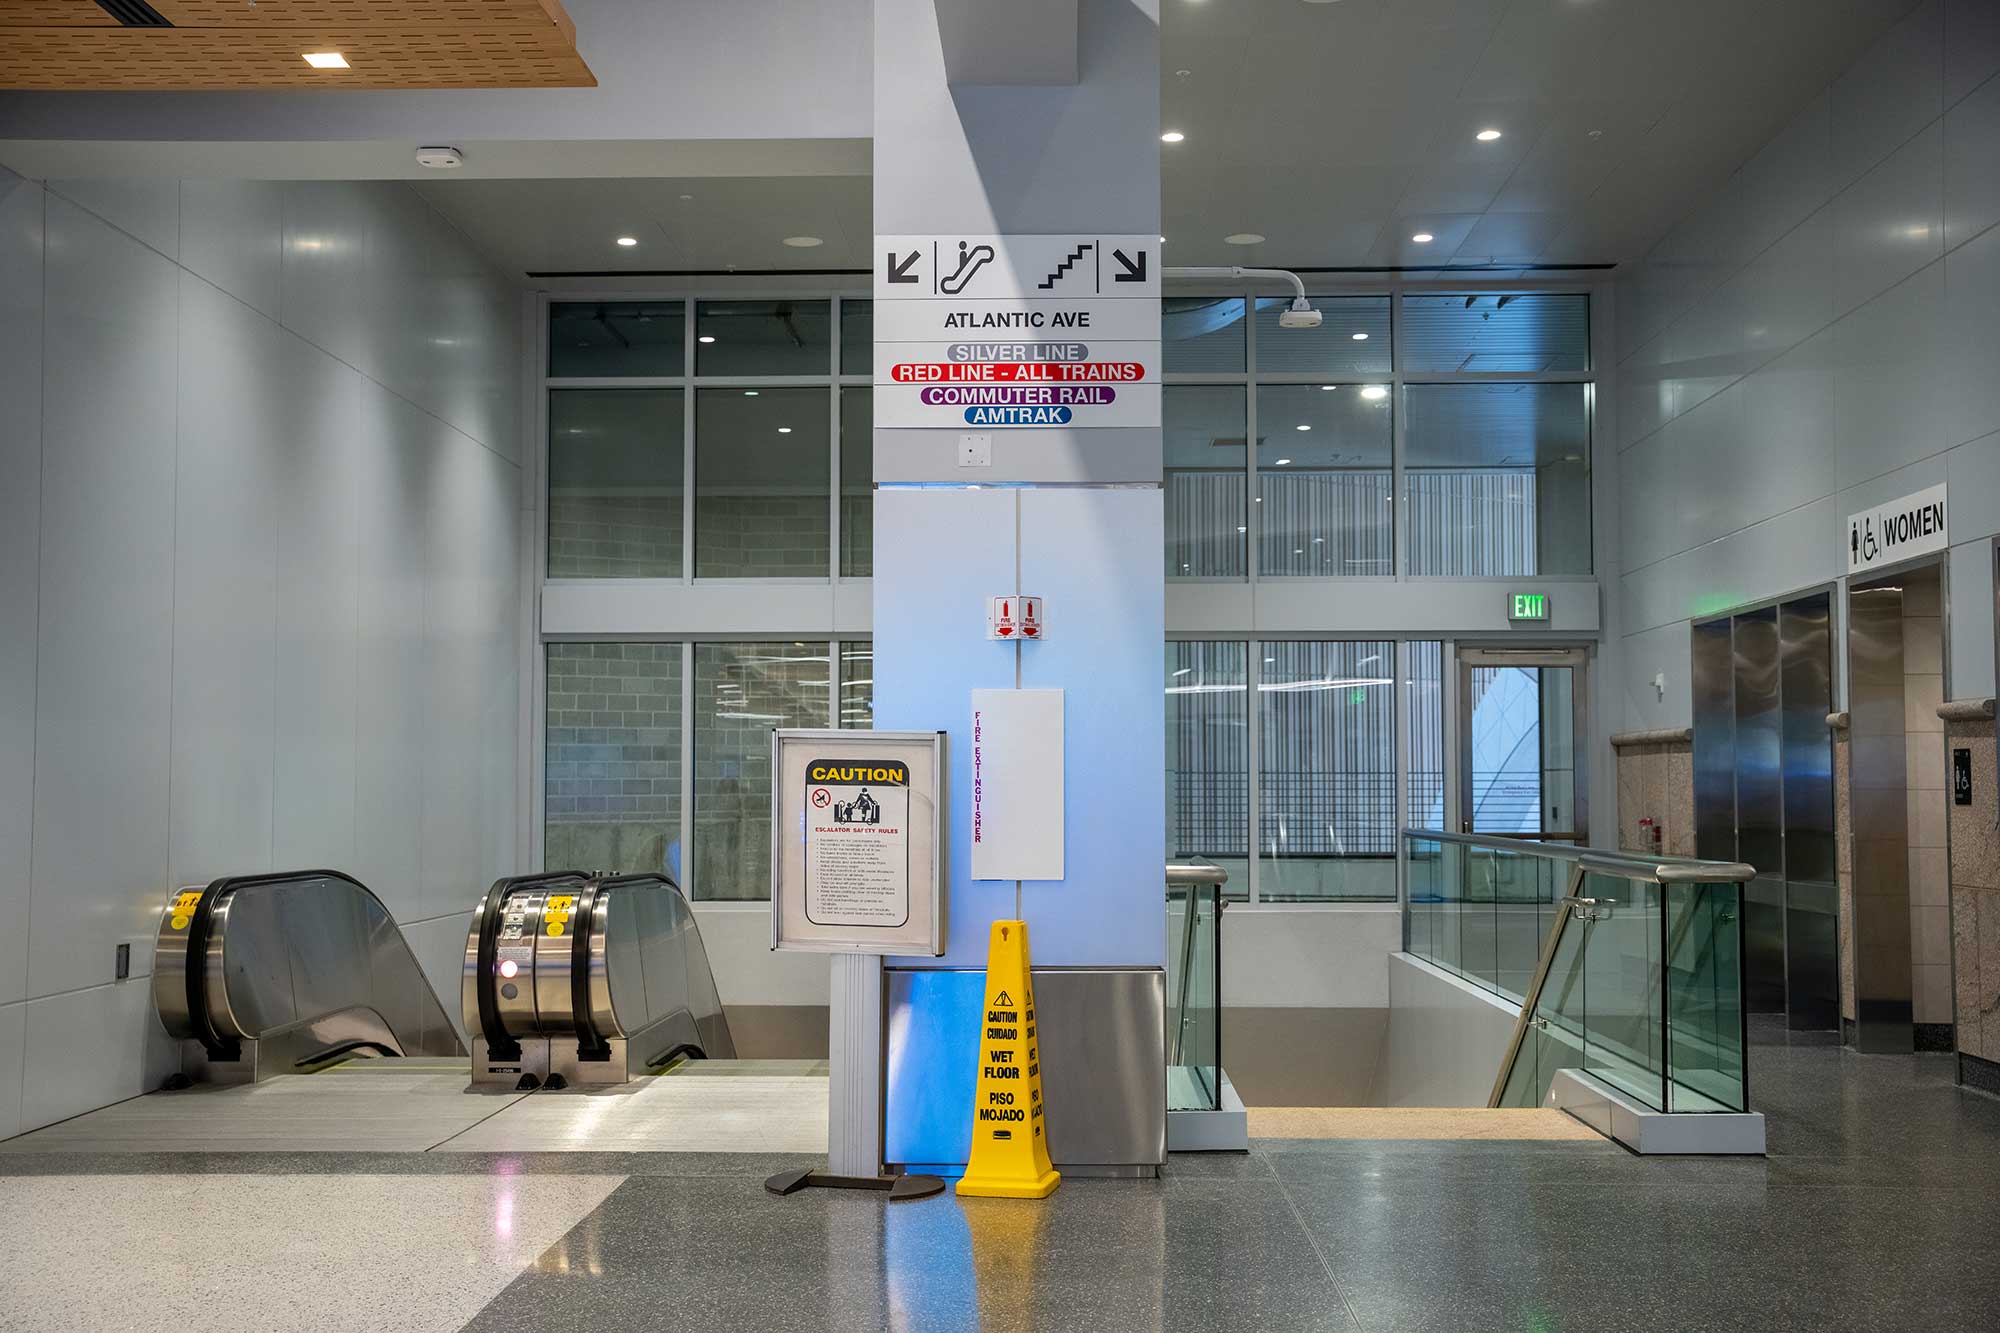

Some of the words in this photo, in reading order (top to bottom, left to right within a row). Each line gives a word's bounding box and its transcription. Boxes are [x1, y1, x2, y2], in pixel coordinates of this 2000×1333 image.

[944, 312, 1045, 328] ATLANTIC
[1051, 312, 1090, 327] AVE
[955, 345, 1026, 361] SILVER
[1033, 345, 1079, 360] LINE
[899, 364, 942, 381] RED
[948, 364, 995, 380] LINE
[1014, 364, 1053, 380] ALL
[1059, 364, 1137, 380] TRAINS
[928, 388, 1051, 404] COMMUTER
[1058, 388, 1107, 404] RAIL
[972, 407, 1063, 424] AMTRAK
[1883, 501, 1944, 547] WOMEN
[1514, 595, 1544, 617] EXIT
[812, 767, 903, 782] CAUTION
[987, 1010, 1017, 1023] CAUTION
[987, 1027, 1018, 1040] CUIDADO
[990, 1051, 1014, 1063] WET
[984, 1067, 1020, 1079] FLOOR
[989, 1092, 1015, 1105] PISO
[980, 1109, 1025, 1122] MOJADO
